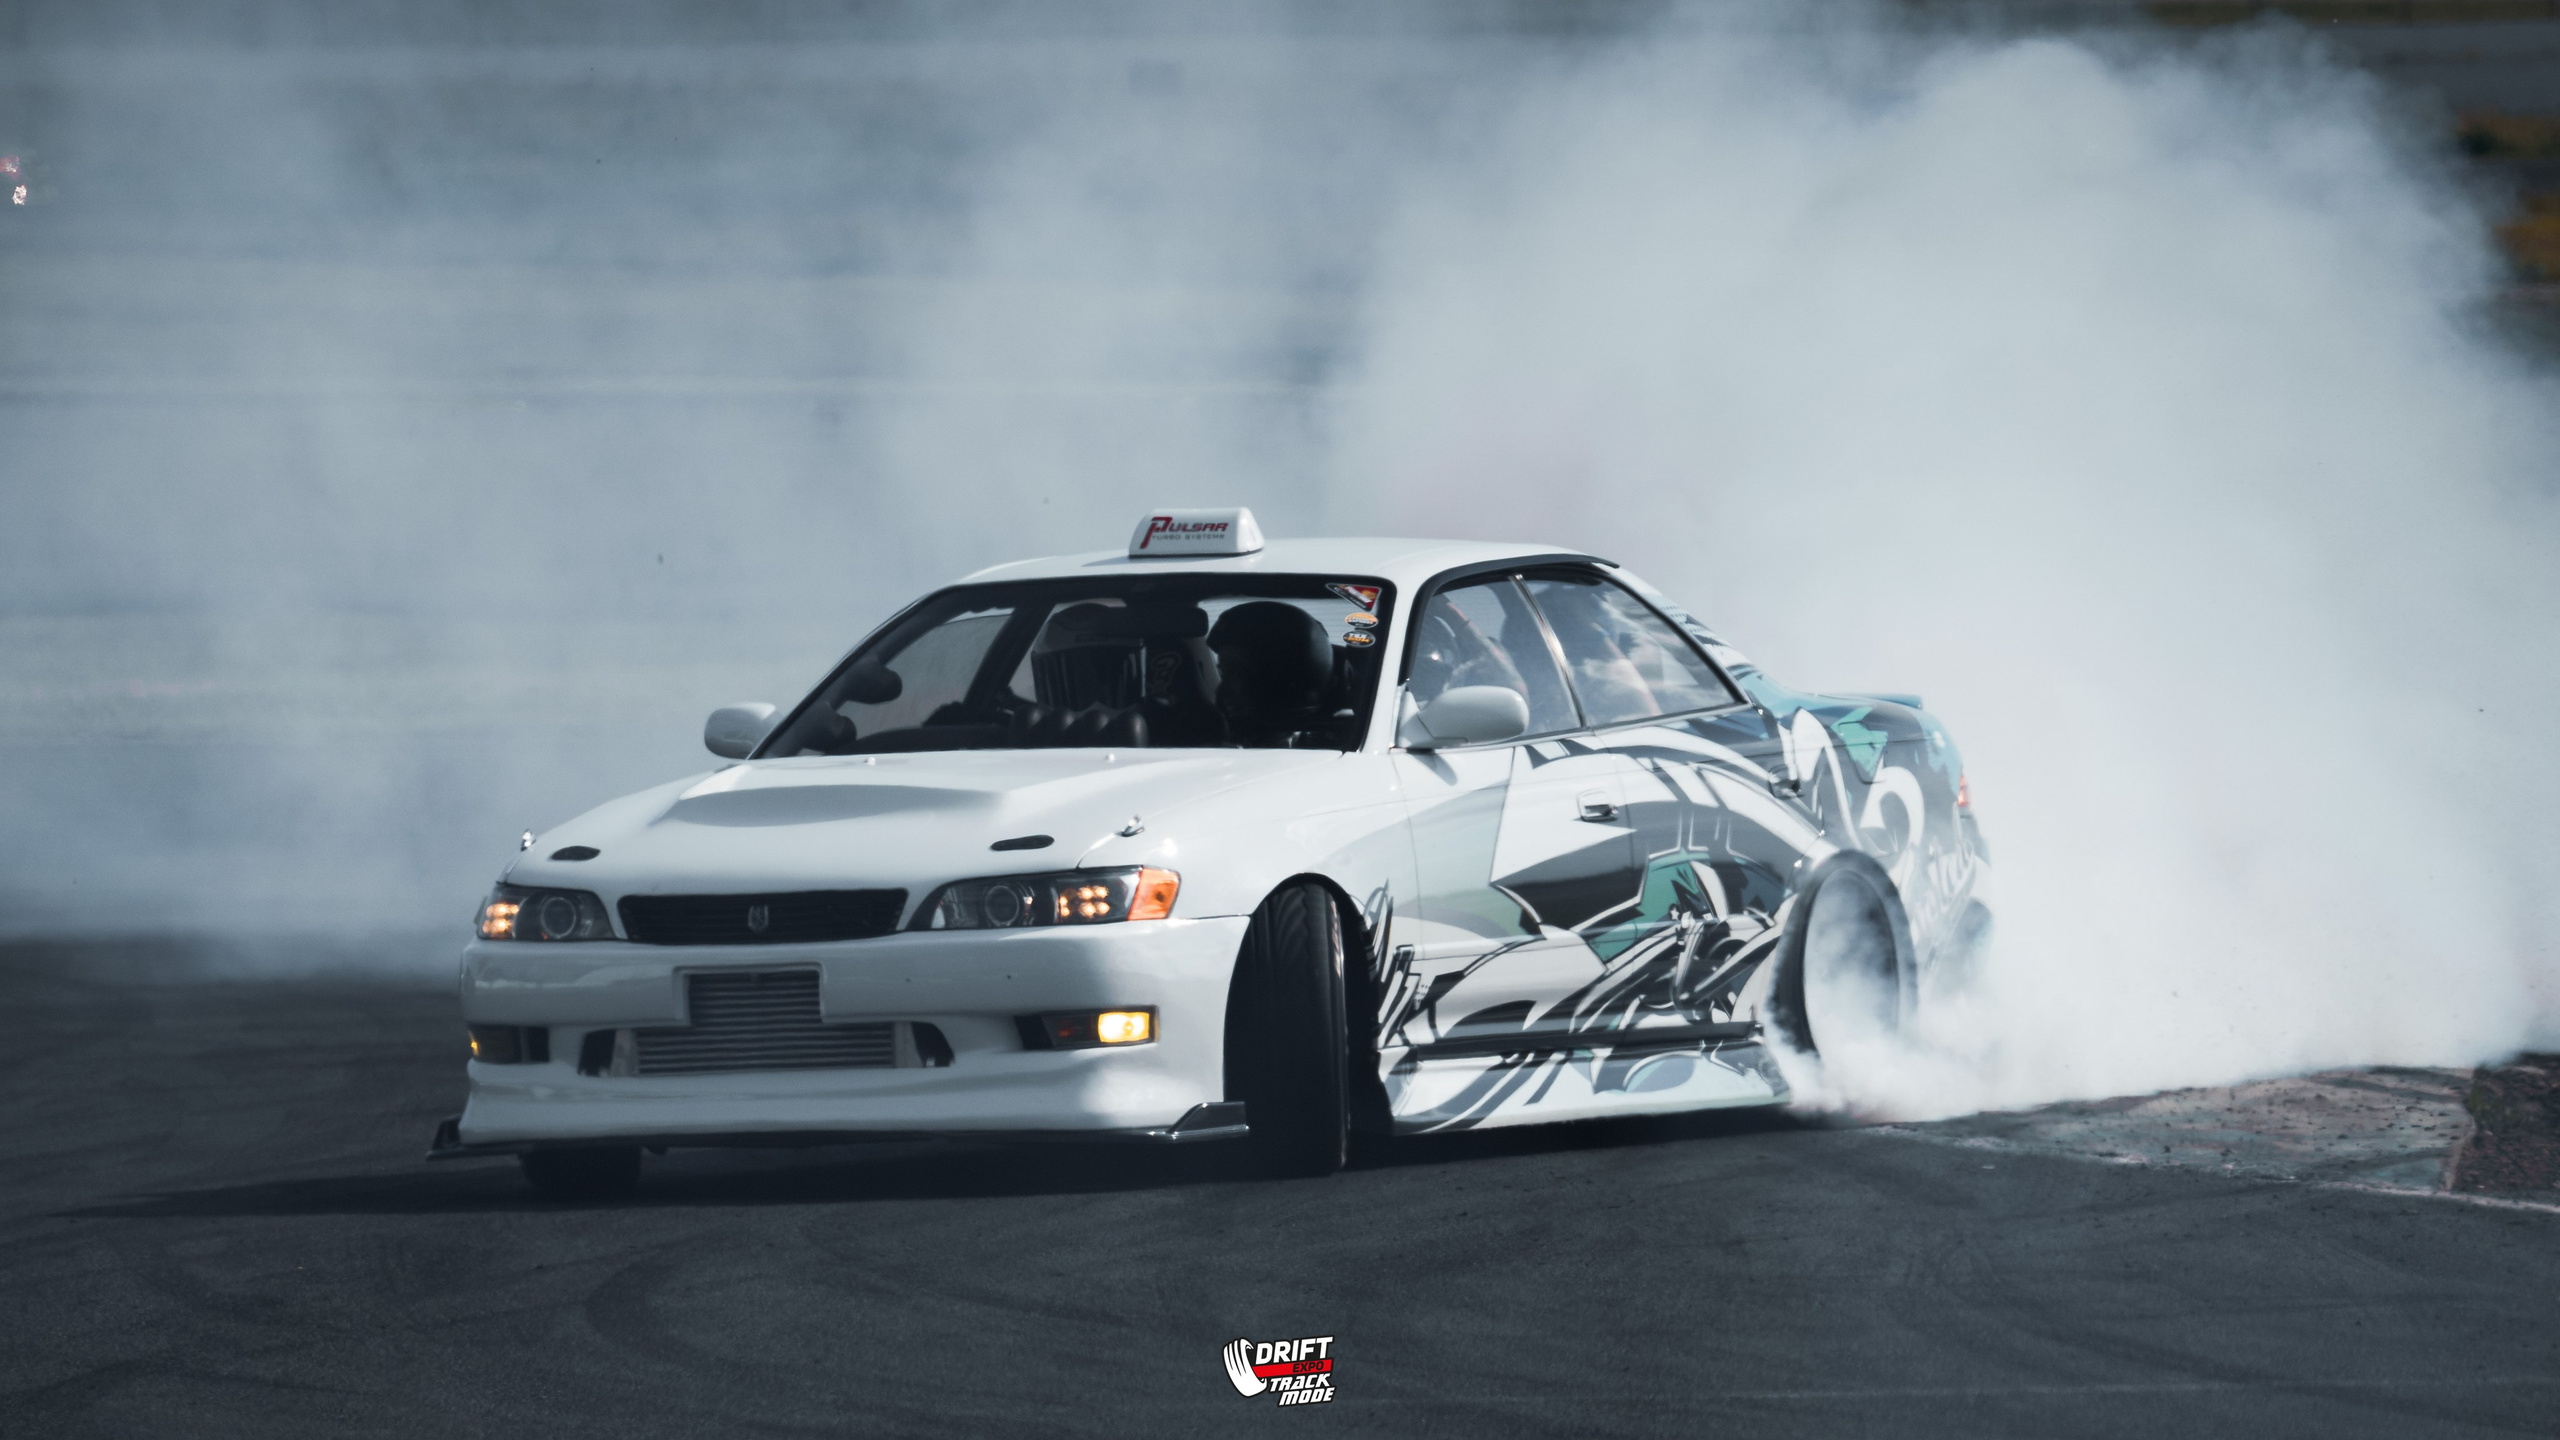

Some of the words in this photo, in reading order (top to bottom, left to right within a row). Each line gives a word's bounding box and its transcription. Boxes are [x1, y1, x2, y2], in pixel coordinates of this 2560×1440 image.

[1140, 516, 1229, 549] PULSAR
[1152, 533, 1181, 541] TURBO
[1185, 532, 1225, 541] SYSTEMS
